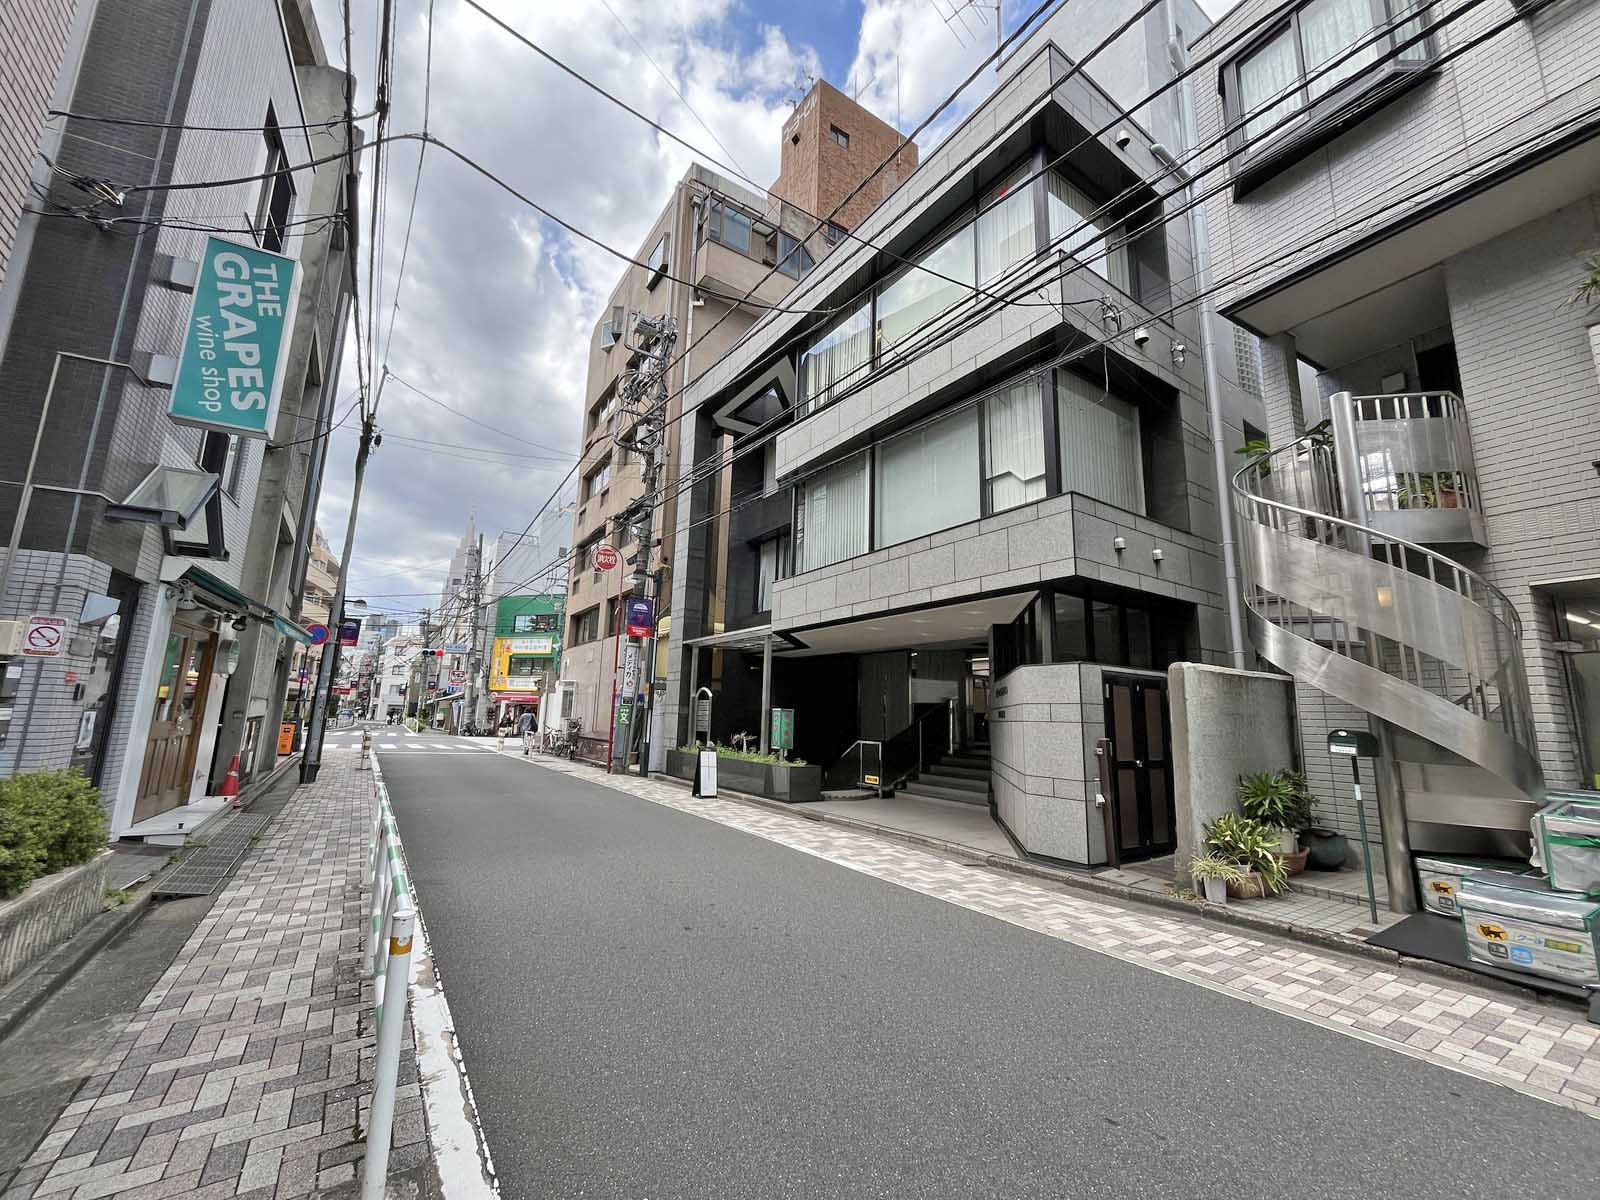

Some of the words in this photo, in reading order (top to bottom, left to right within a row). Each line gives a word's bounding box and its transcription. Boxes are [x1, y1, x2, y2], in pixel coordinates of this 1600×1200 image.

[253, 263, 282, 317] THE
[195, 315, 219, 361] wine
[213, 252, 266, 411] GRAPES
[198, 367, 226, 413] shop
